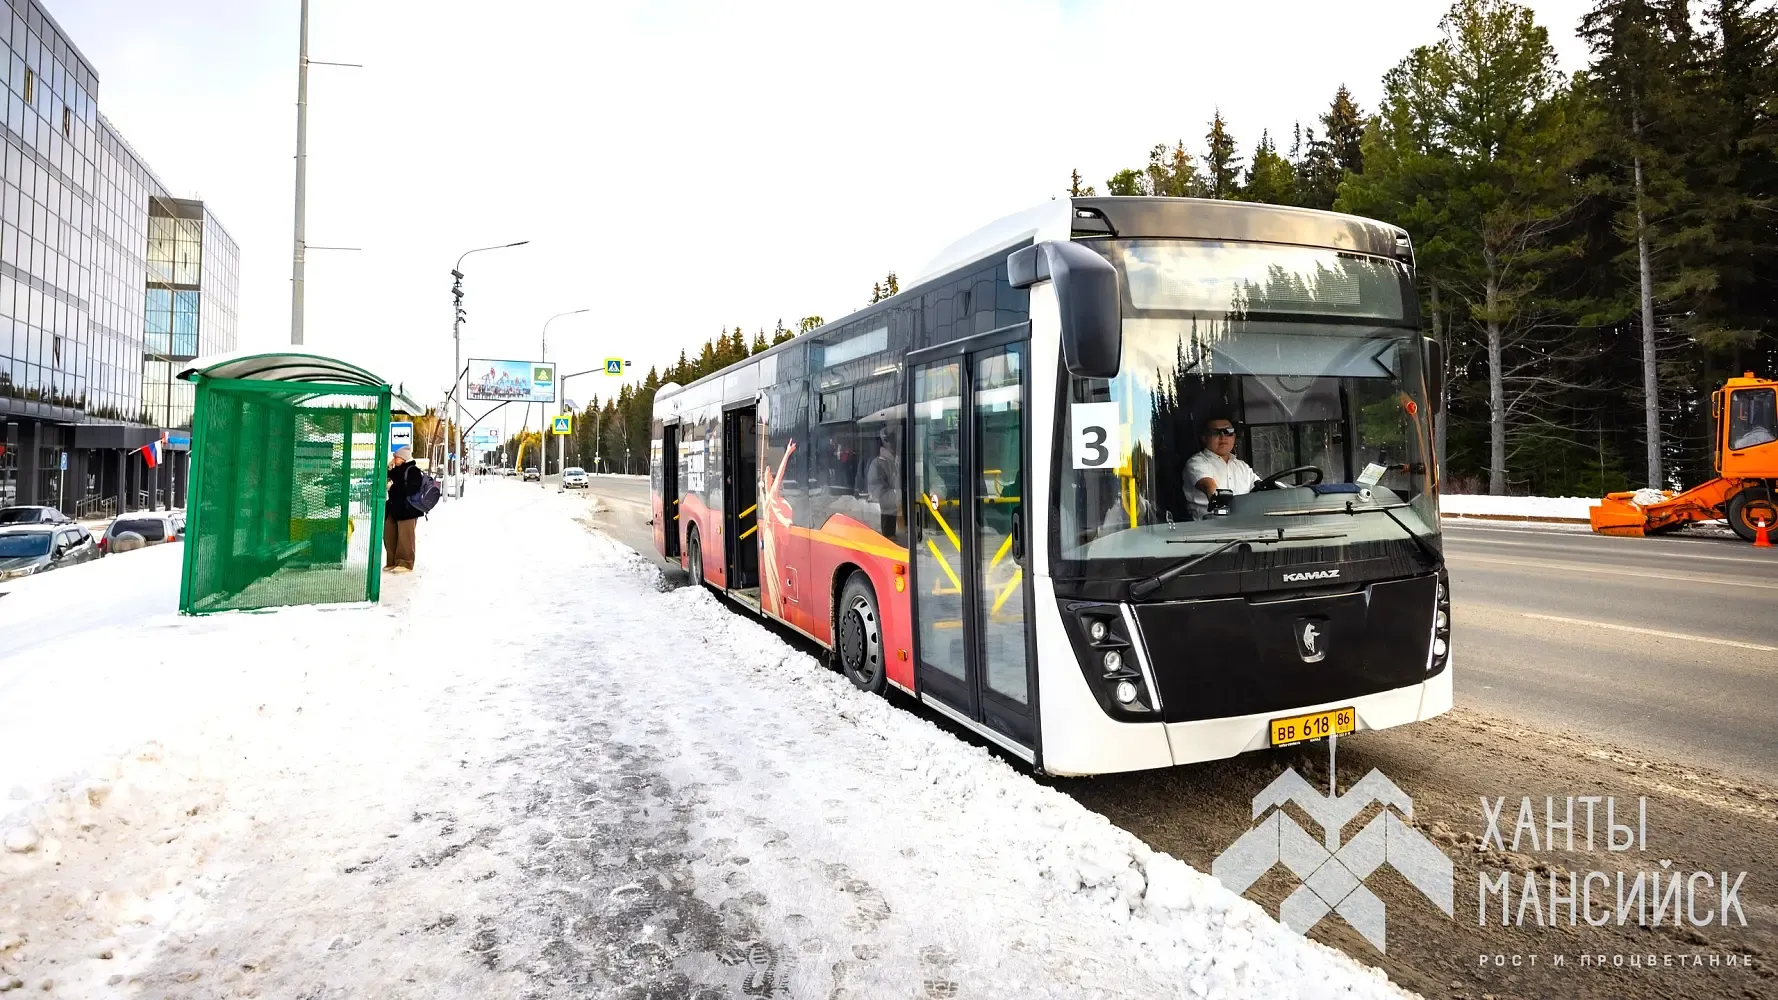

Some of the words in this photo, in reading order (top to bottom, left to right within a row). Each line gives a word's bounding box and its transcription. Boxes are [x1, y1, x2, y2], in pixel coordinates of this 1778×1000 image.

[1082, 426, 1109, 467] 3
[1283, 569, 1340, 582] KAMAZ
[1303, 716, 1329, 736] 618
[1337, 712, 1350, 726] 86
